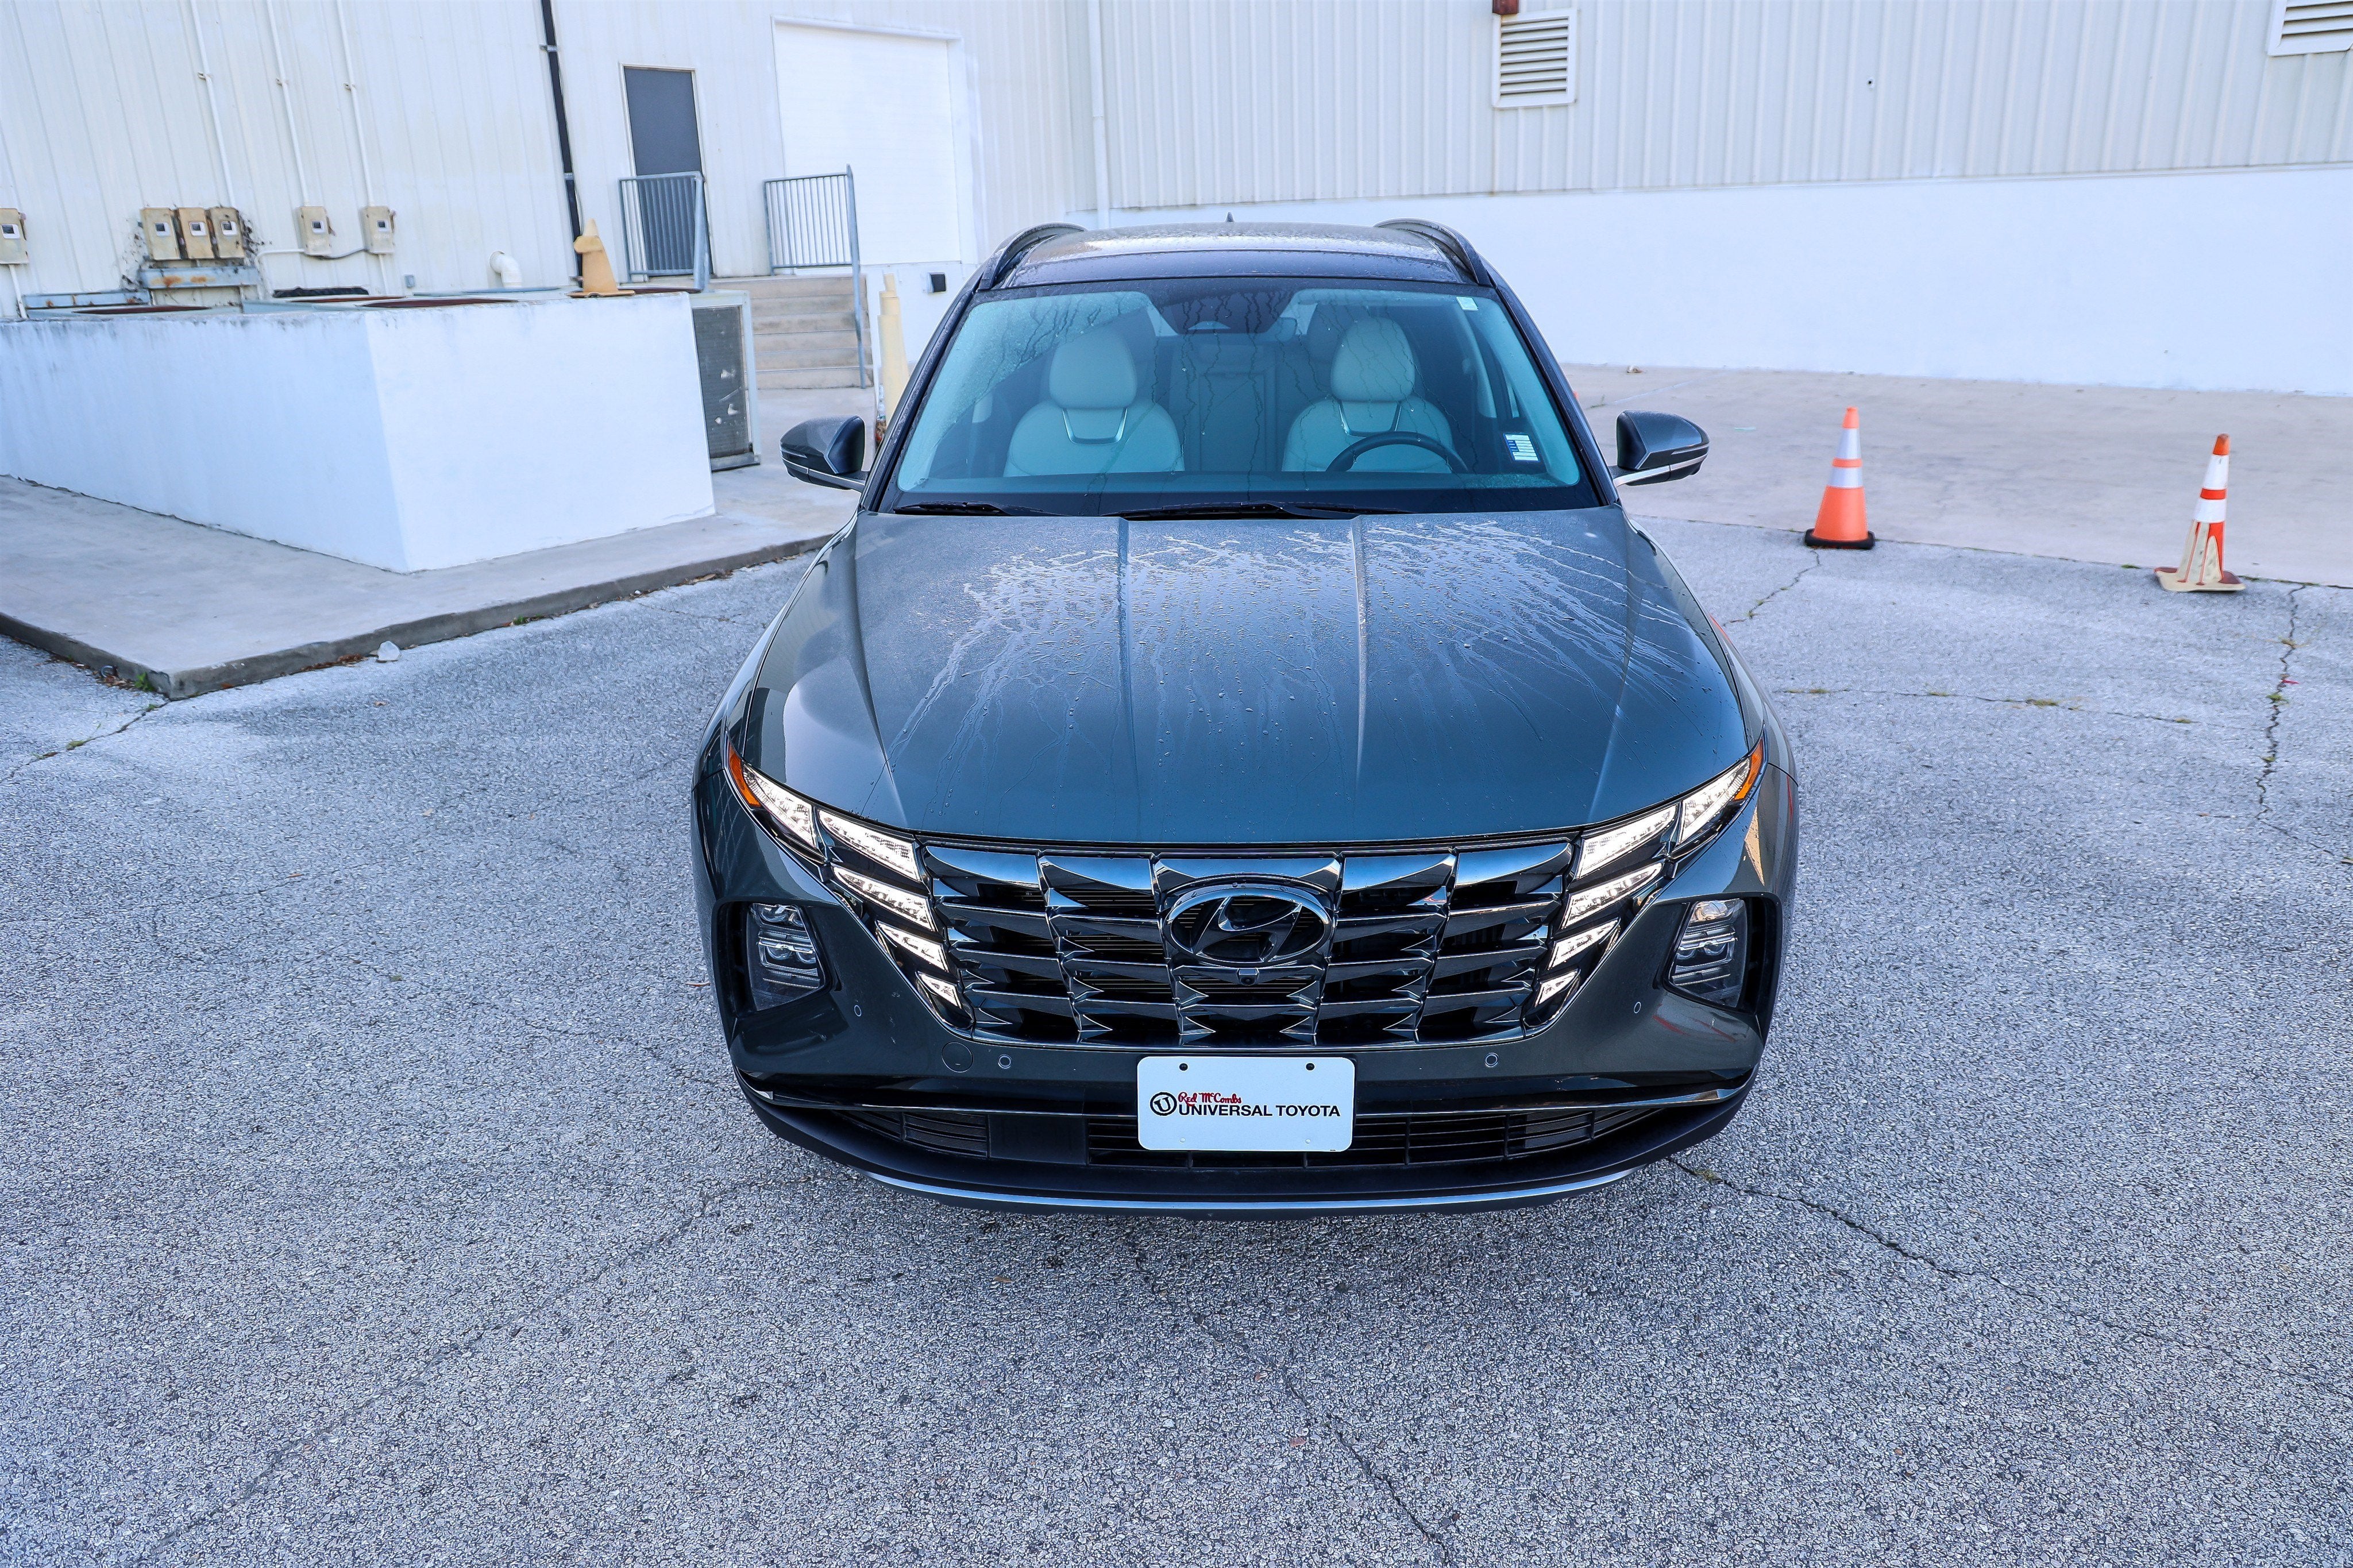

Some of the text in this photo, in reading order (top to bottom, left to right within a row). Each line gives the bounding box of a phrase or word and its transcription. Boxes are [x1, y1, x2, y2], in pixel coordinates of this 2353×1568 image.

[1178, 1092, 1242, 1107] Red McCombs
[1179, 1104, 1341, 1117] UNIVERSAL TOYOTA
